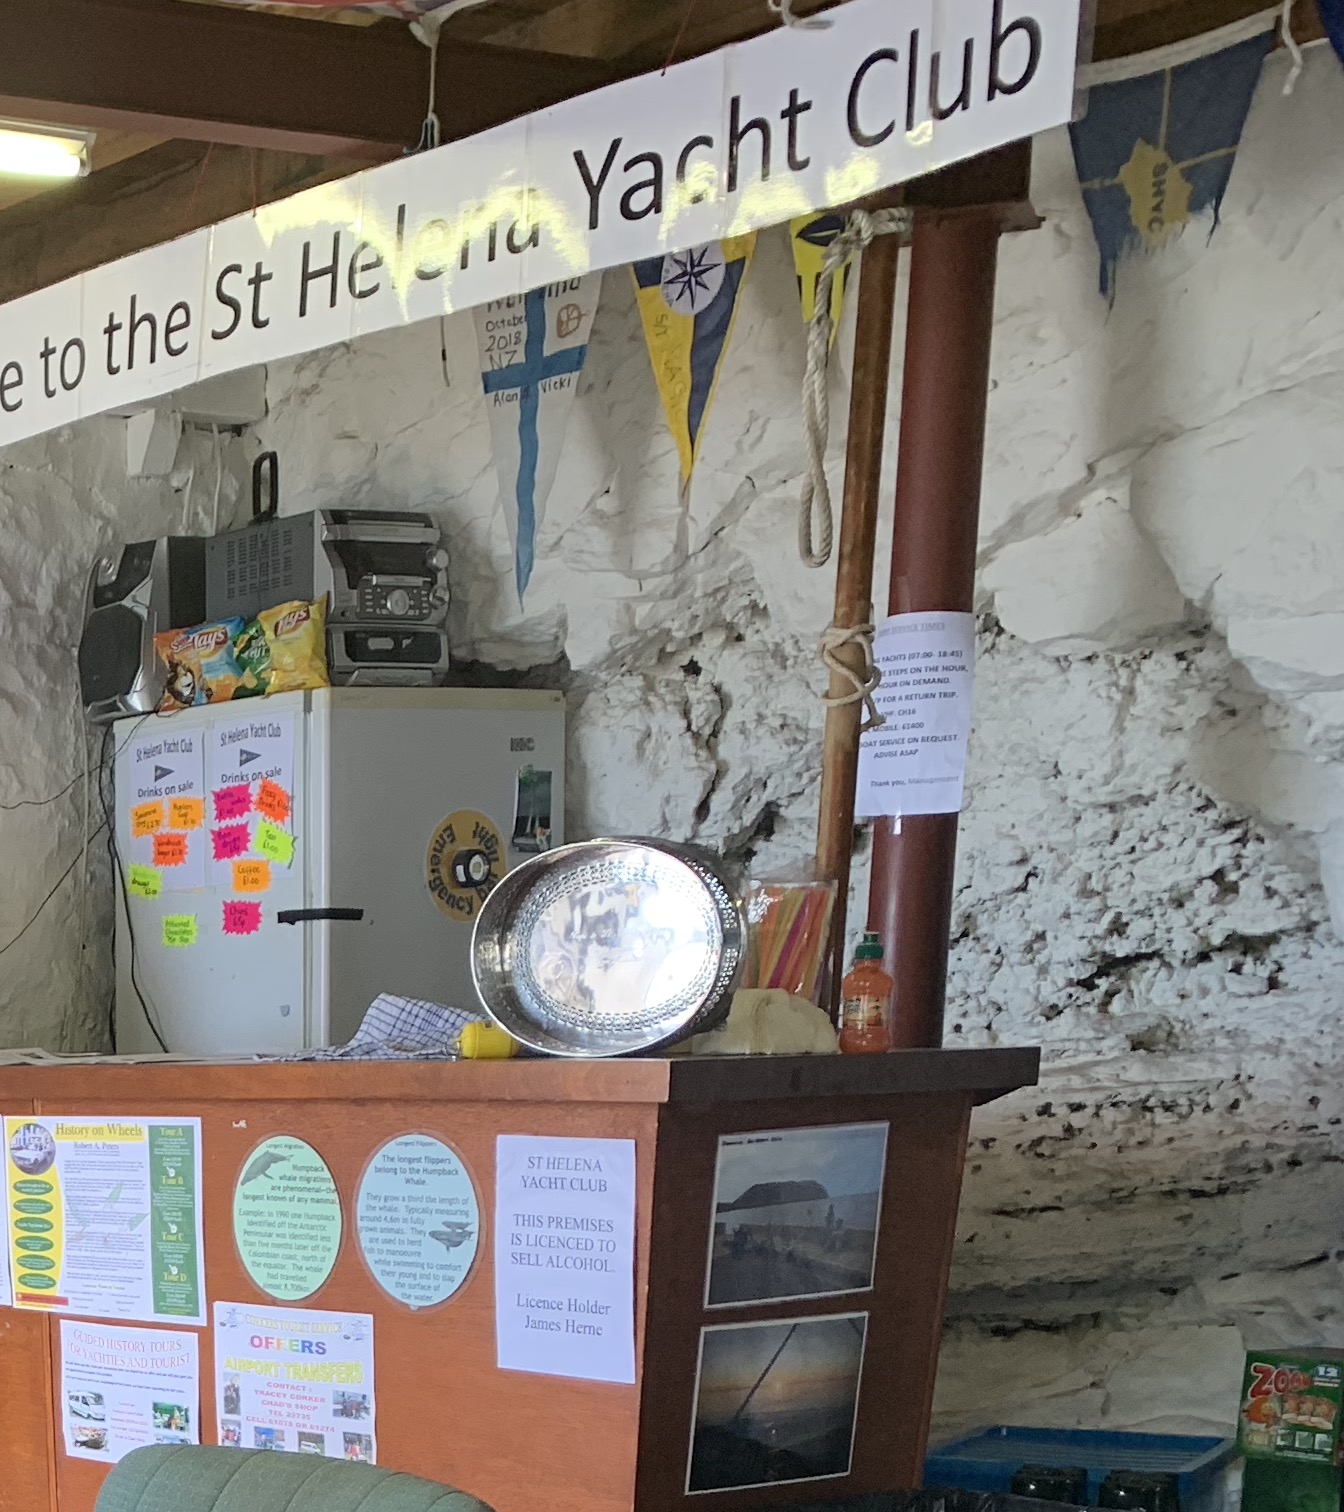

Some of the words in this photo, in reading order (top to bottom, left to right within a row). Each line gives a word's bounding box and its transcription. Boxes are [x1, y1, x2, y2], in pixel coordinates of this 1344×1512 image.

[39, 329, 85, 398] to
[103, 294, 190, 375] the
[210, 260, 273, 341] St
[298, 187, 541, 317] Helena
[573, 87, 813, 230] Yacht
[847, 0, 1043, 149] Club
[485, 331, 522, 352] 2018
[541, 376, 571, 393] Vicki
[888, 667, 908, 676] STEPS
[905, 692, 936, 700] RETURN
[220, 733, 227, 746] St
[227, 728, 249, 744] Helena
[250, 723, 267, 739] Yacht
[268, 723, 282, 737] Club
[879, 738, 906, 747] SERVICE
[136, 748, 142, 762] St
[143, 745, 162, 759] Helena
[164, 740, 179, 753] Yacht
[181, 739, 193, 753] Club
[221, 771, 249, 784] Drinks
[251, 770, 262, 781] on
[265, 766, 282, 779] sale
[137, 785, 162, 798] Drinks
[165, 784, 176, 794] on
[178, 780, 194, 792] sale
[237, 865, 261, 874] Coffee
[428, 823, 474, 915] Emergency
[243, 875, 260, 885] £1.00
[56, 1124, 89, 1137] History
[92, 1126, 104, 1135] on
[107, 1124, 142, 1136] Wheels
[382, 1154, 395, 1163] The
[397, 1155, 422, 1164] longest
[425, 1156, 451, 1165] flippers
[528, 1156, 544, 1169] ST
[546, 1156, 603, 1173] HELENA
[292, 1164, 325, 1173] Humpback
[375, 1166, 398, 1176] belong
[422, 1168, 459, 1176] Humpback
[299, 1174, 332, 1184] migrations
[521, 1175, 568, 1191] YACHT
[570, 1178, 608, 1193] CLUB
[243, 1193, 264, 1201] longest
[266, 1193, 287, 1201] known
[289, 1194, 295, 1202] of
[297, 1195, 308, 1204] any
[304, 1213, 336, 1222] Humpback
[513, 1213, 544, 1228] THIS
[547, 1216, 614, 1233] PREMISES
[511, 1233, 522, 1246] IS
[526, 1234, 594, 1251] LICENCED
[598, 1238, 616, 1253] TO
[511, 1252, 543, 1267] SELL
[546, 1255, 616, 1273] ALCOHOL.
[516, 1293, 563, 1311] Licence
[568, 1297, 611, 1315] Holder
[525, 1314, 561, 1332] James
[565, 1319, 603, 1336] Herne
[107, 1340, 146, 1352] HISTORY
[150, 1340, 182, 1352] TOURS
[250, 1335, 327, 1355] OFFERS
[127, 1358, 148, 1368] AND
[224, 1357, 281, 1377] AIRPORT
[285, 1360, 363, 1384] TRANSFERS
[267, 1382, 306, 1392] CONTACT
[255, 1389, 287, 1400] TRACEY
[294, 1403, 319, 1411] SHOP
[246, 1416, 267, 1424] CELL
